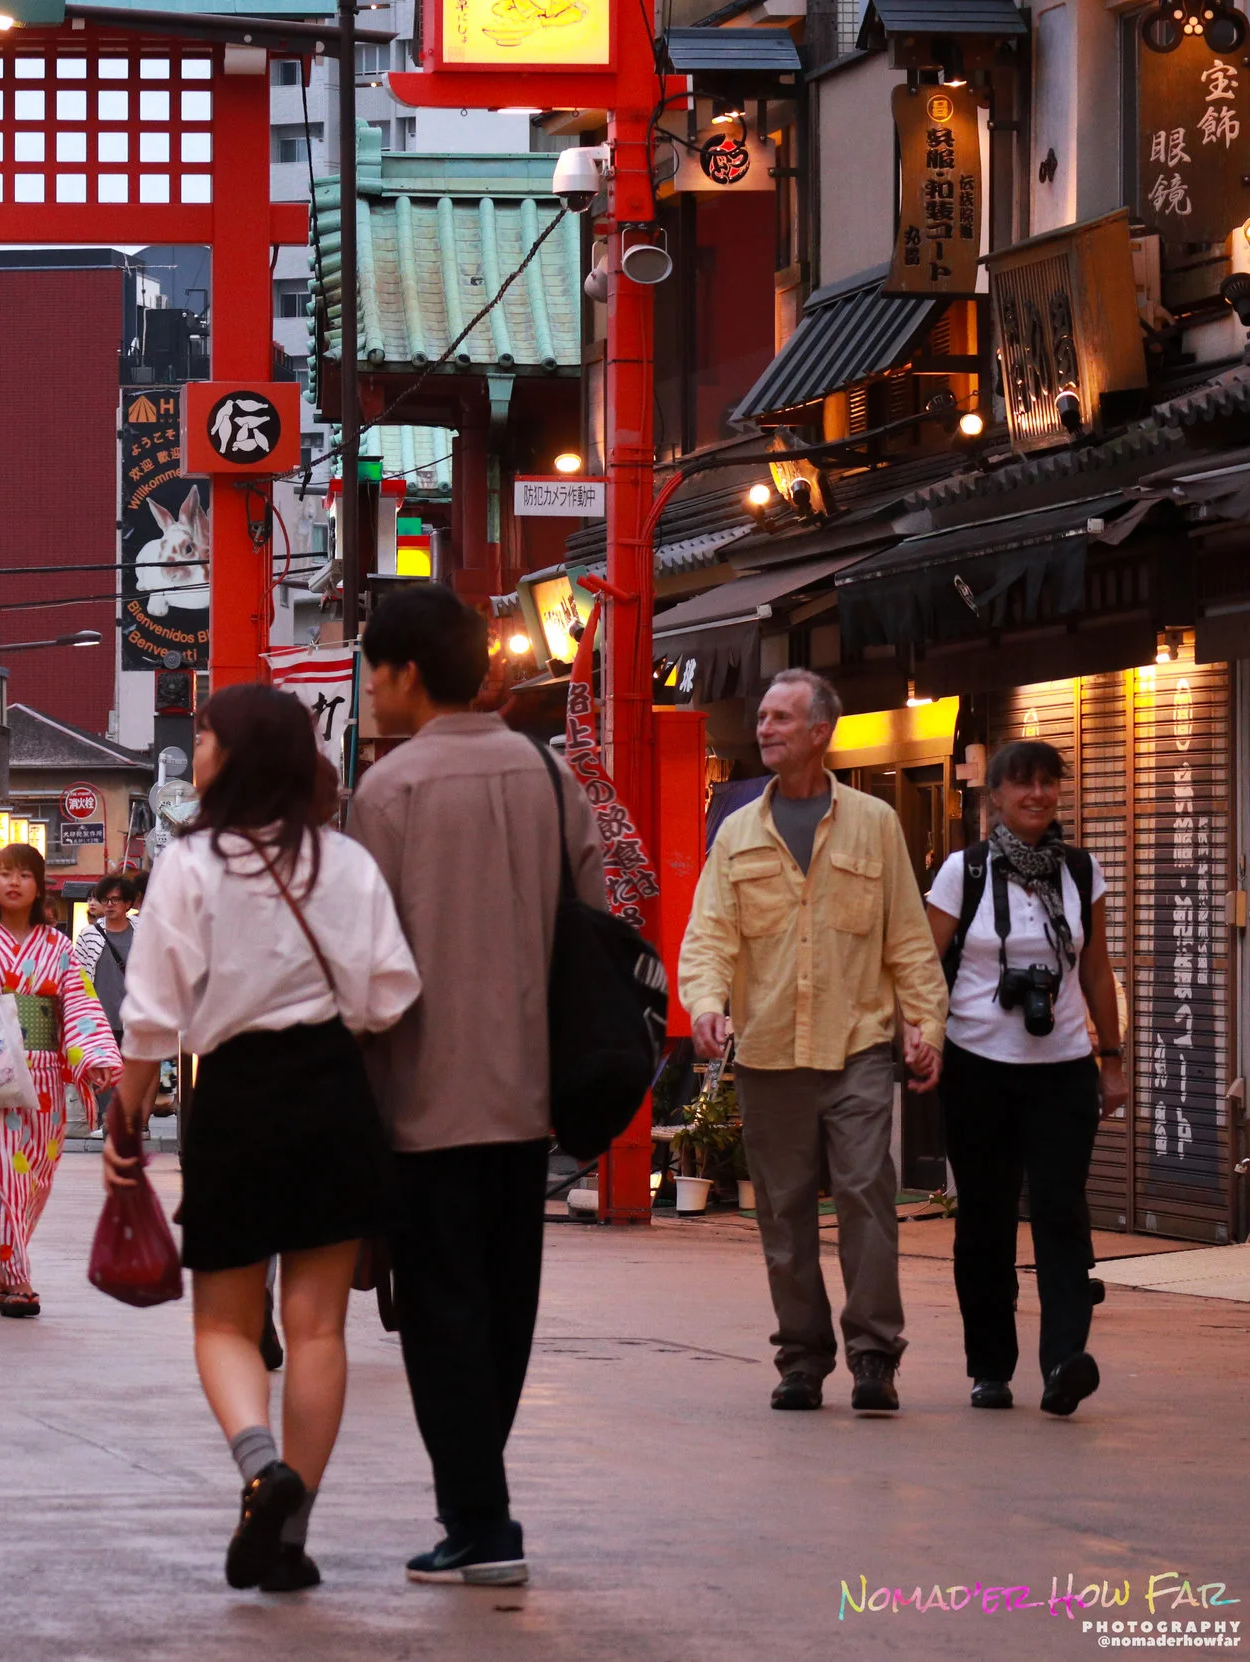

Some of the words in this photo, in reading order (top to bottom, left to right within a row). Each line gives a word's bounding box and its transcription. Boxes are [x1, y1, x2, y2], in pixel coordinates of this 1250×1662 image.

[1197, 60, 1240, 149] 宝飾
[1148, 127, 1192, 216] 眼鏡
[131, 428, 177, 457] ようこそ
[210, 398, 271, 455] 伝
[523, 484, 596, 507] 防犯カメラ作動中
[127, 600, 196, 643] Bienvenidos
[128, 629, 197, 661] Benveti
